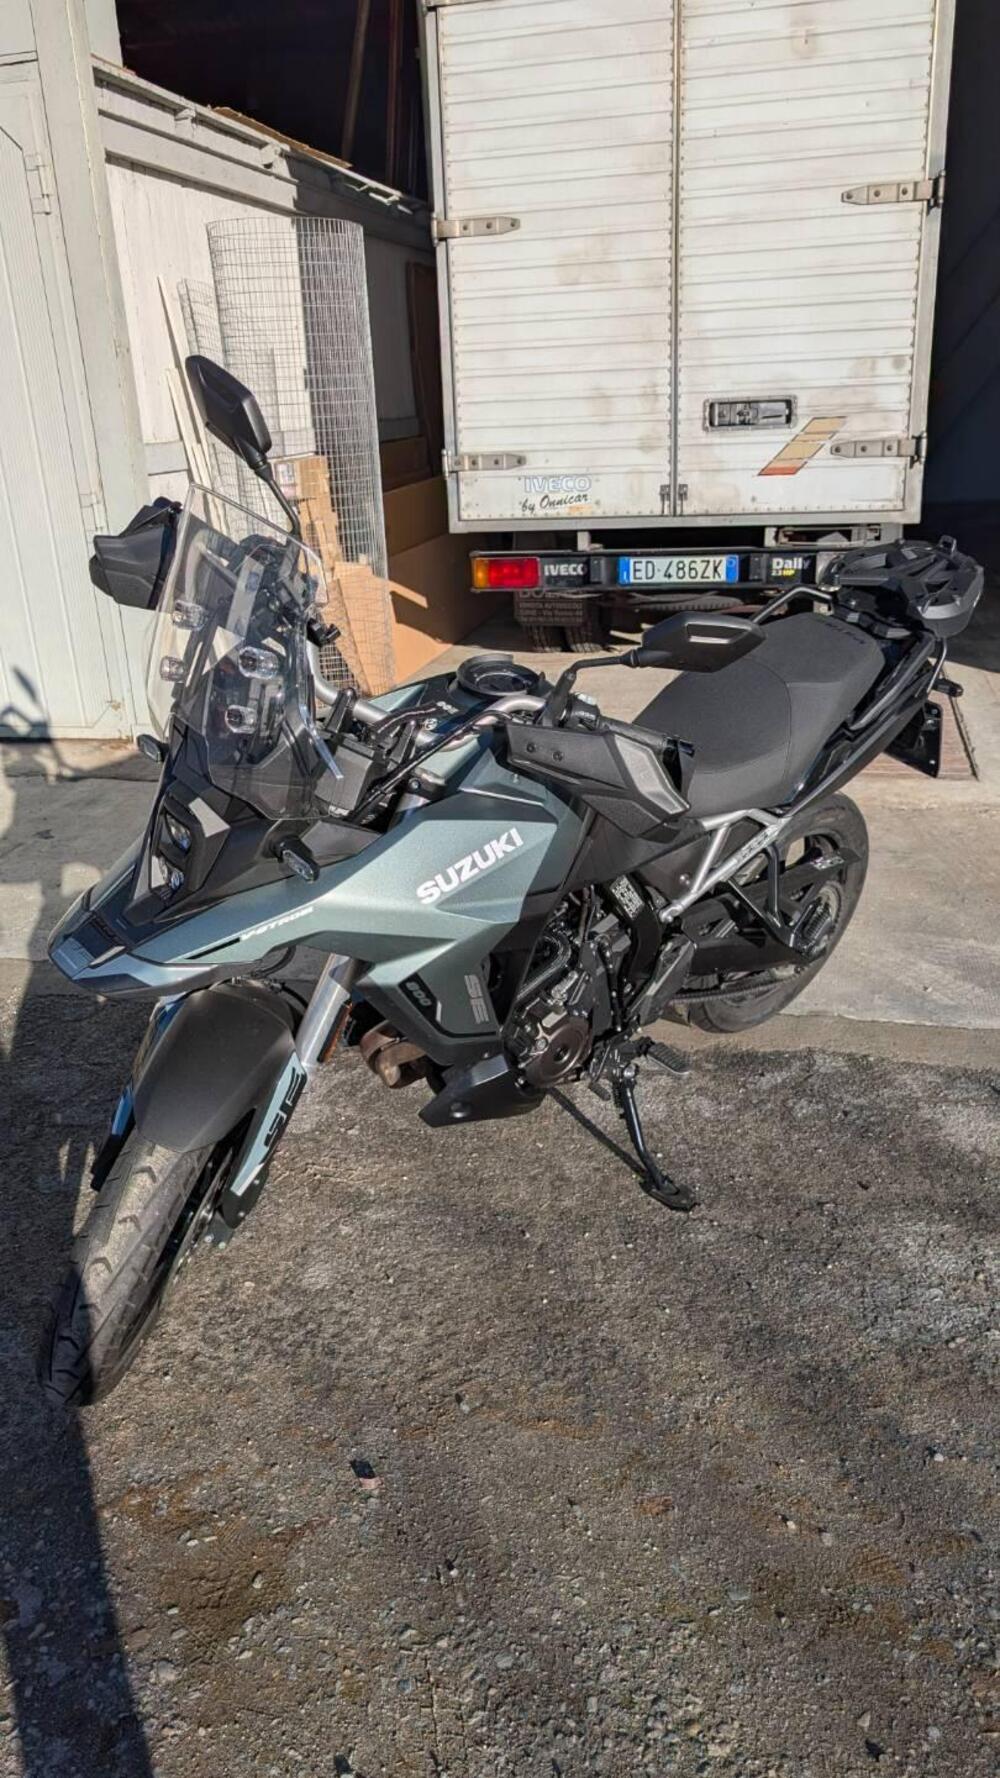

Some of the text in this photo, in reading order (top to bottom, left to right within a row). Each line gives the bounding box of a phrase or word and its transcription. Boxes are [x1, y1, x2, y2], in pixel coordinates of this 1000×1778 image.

[524, 475, 593, 493] IVECO
[521, 497, 536, 514] by
[544, 563, 587, 576] IVECO
[416, 828, 524, 904] SUZUKI
